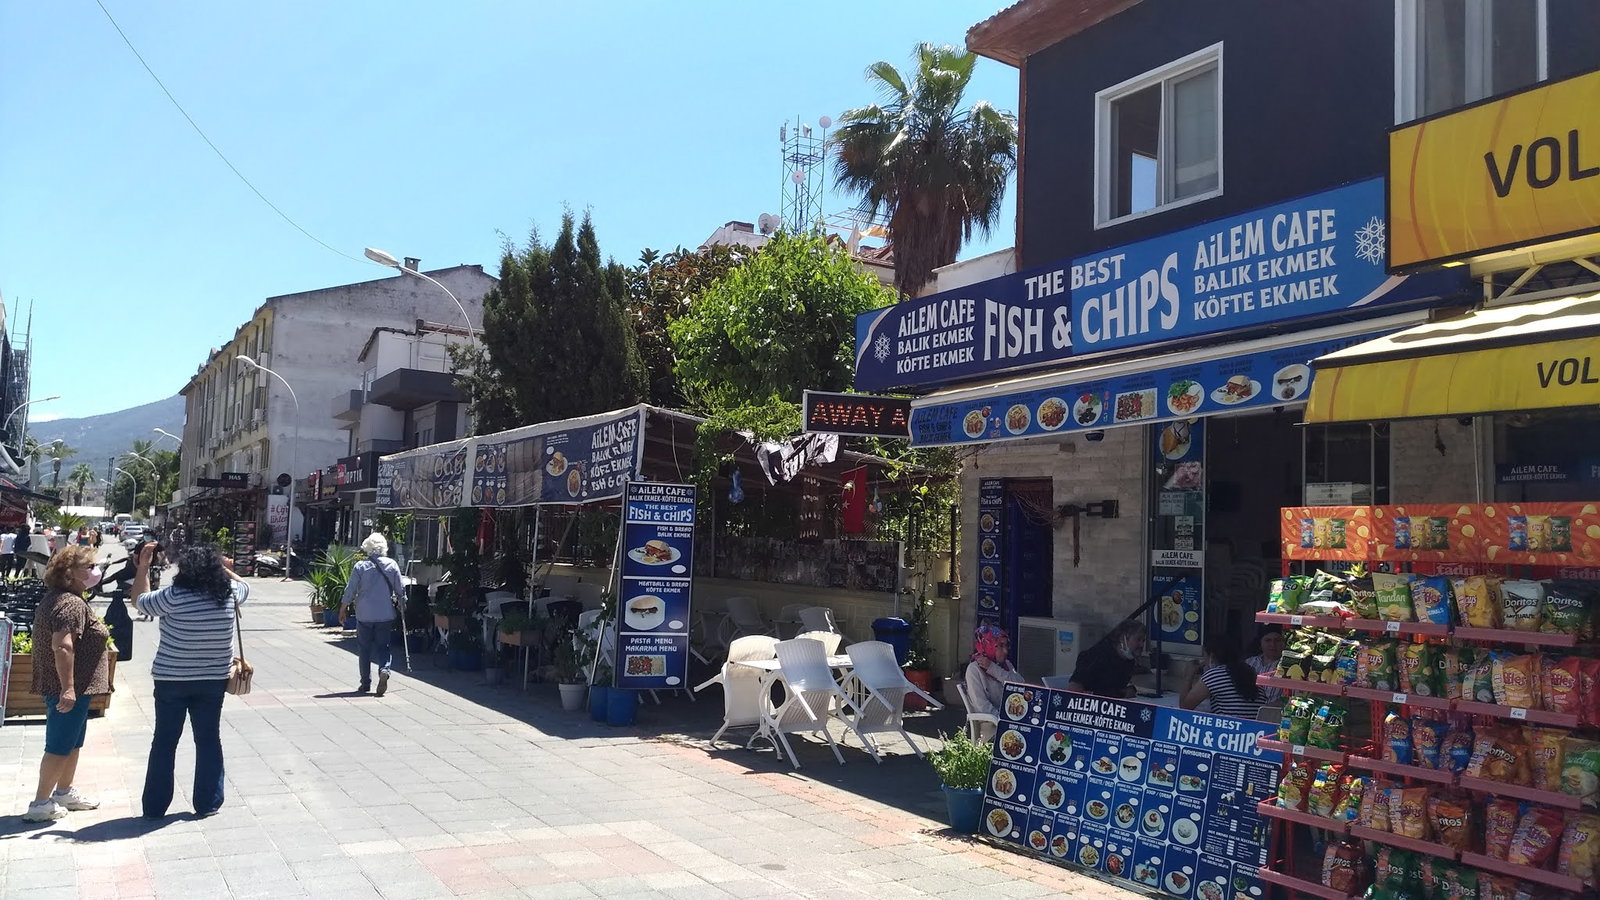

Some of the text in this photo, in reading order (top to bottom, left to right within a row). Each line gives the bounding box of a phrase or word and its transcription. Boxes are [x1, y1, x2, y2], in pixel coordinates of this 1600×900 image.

[1484, 129, 1600, 198] VOL
[1272, 209, 1337, 253] CAFE
[1024, 254, 1125, 300] THE BEST
[1194, 246, 1337, 295] BALIK EKMEK
[984, 252, 1180, 361] FISH & CHIPS
[1194, 274, 1340, 321] KÖFTE EKMEK
[940, 300, 975, 323] CAFE
[898, 326, 974, 355] BALIK EKMEK
[897, 347, 975, 374] KÖFTE EKMEK
[1537, 356, 1600, 389] VOL
[810, 402, 884, 427] AWAY
[666, 488, 686, 496] CAFE
[629, 506, 692, 522] FISH & CHIPS
[1180, 552, 1194, 560] CAFE
[1505, 598, 1538, 608] Doritos
[1546, 596, 1583, 608] Doritos
[1056, 711, 1136, 734] BALIK EKMEK-KÖFTE EKMEK
[1100, 700, 1127, 719] CAFE
[1192, 714, 1242, 731] THE BEST
[1168, 716, 1265, 756] FISH & CHIPS
